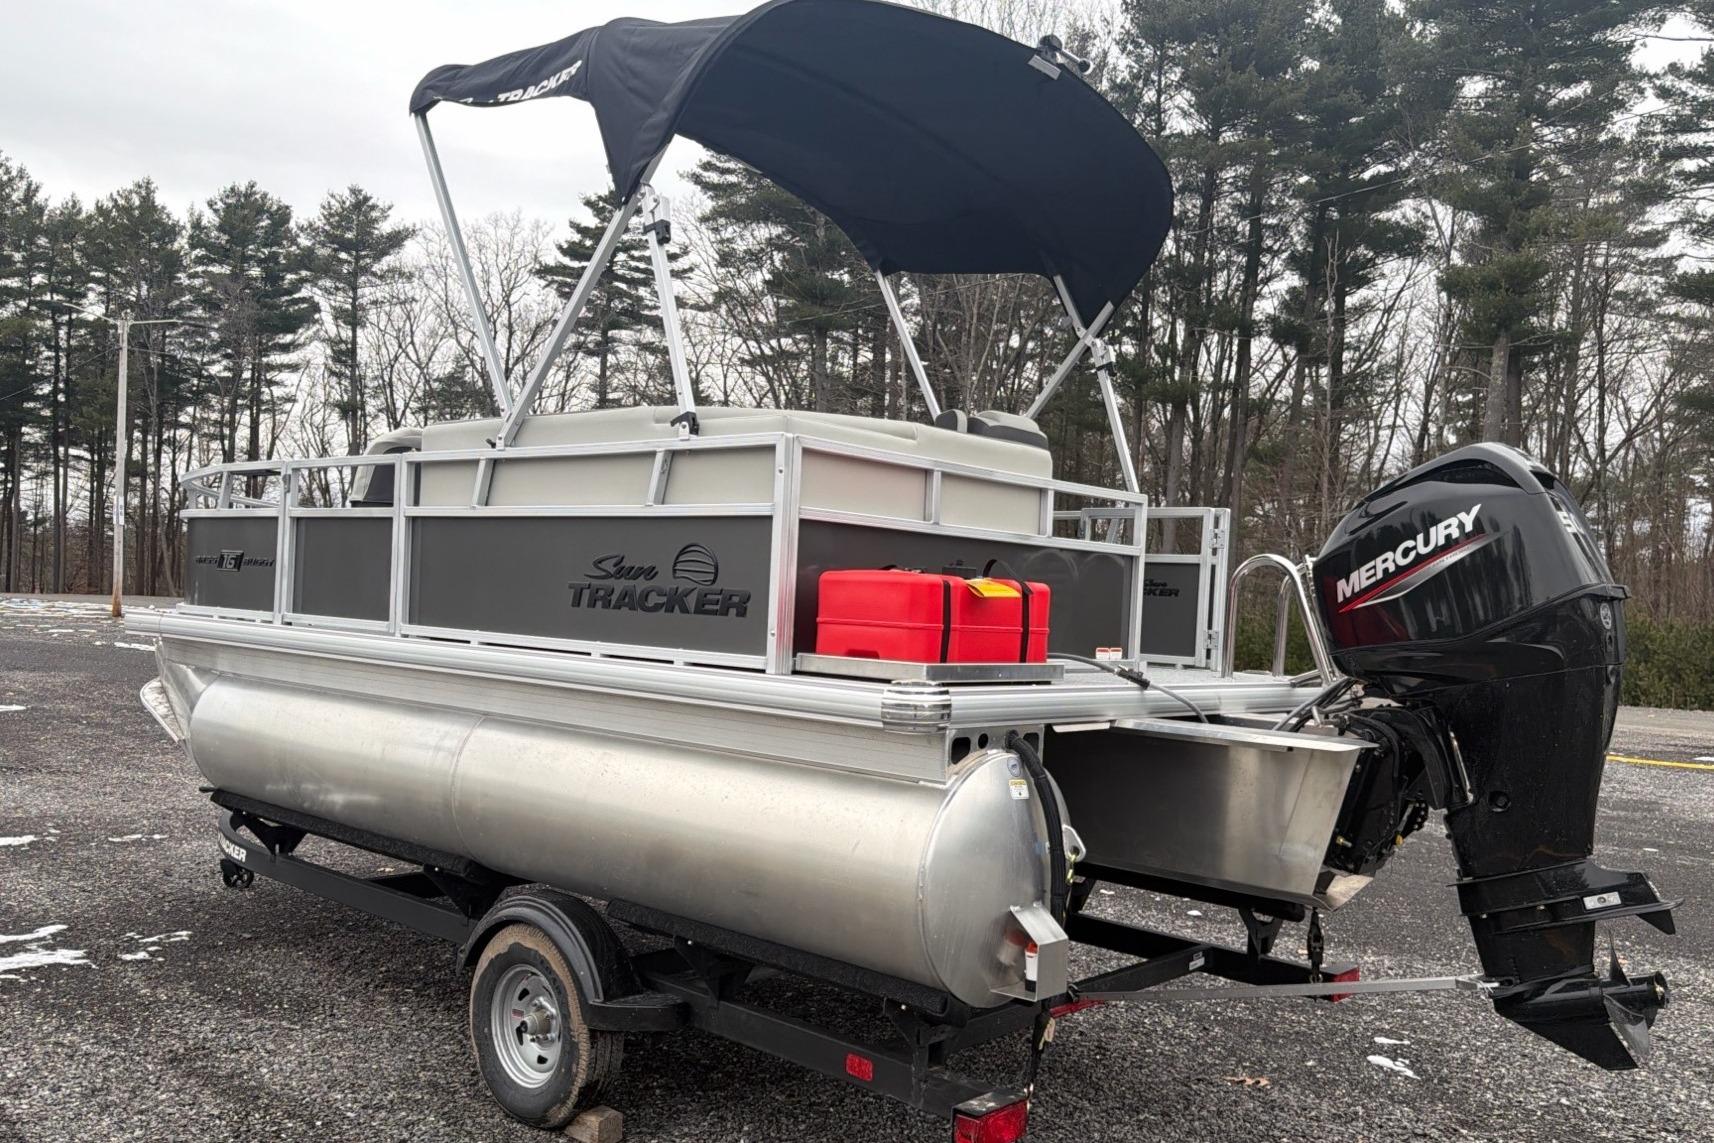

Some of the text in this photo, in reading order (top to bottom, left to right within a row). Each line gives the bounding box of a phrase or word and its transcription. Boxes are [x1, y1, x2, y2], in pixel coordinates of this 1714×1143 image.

[584, 554, 659, 581] Sun
[1336, 503, 1482, 604] MERCURY
[568, 582, 751, 618] TRACKER
